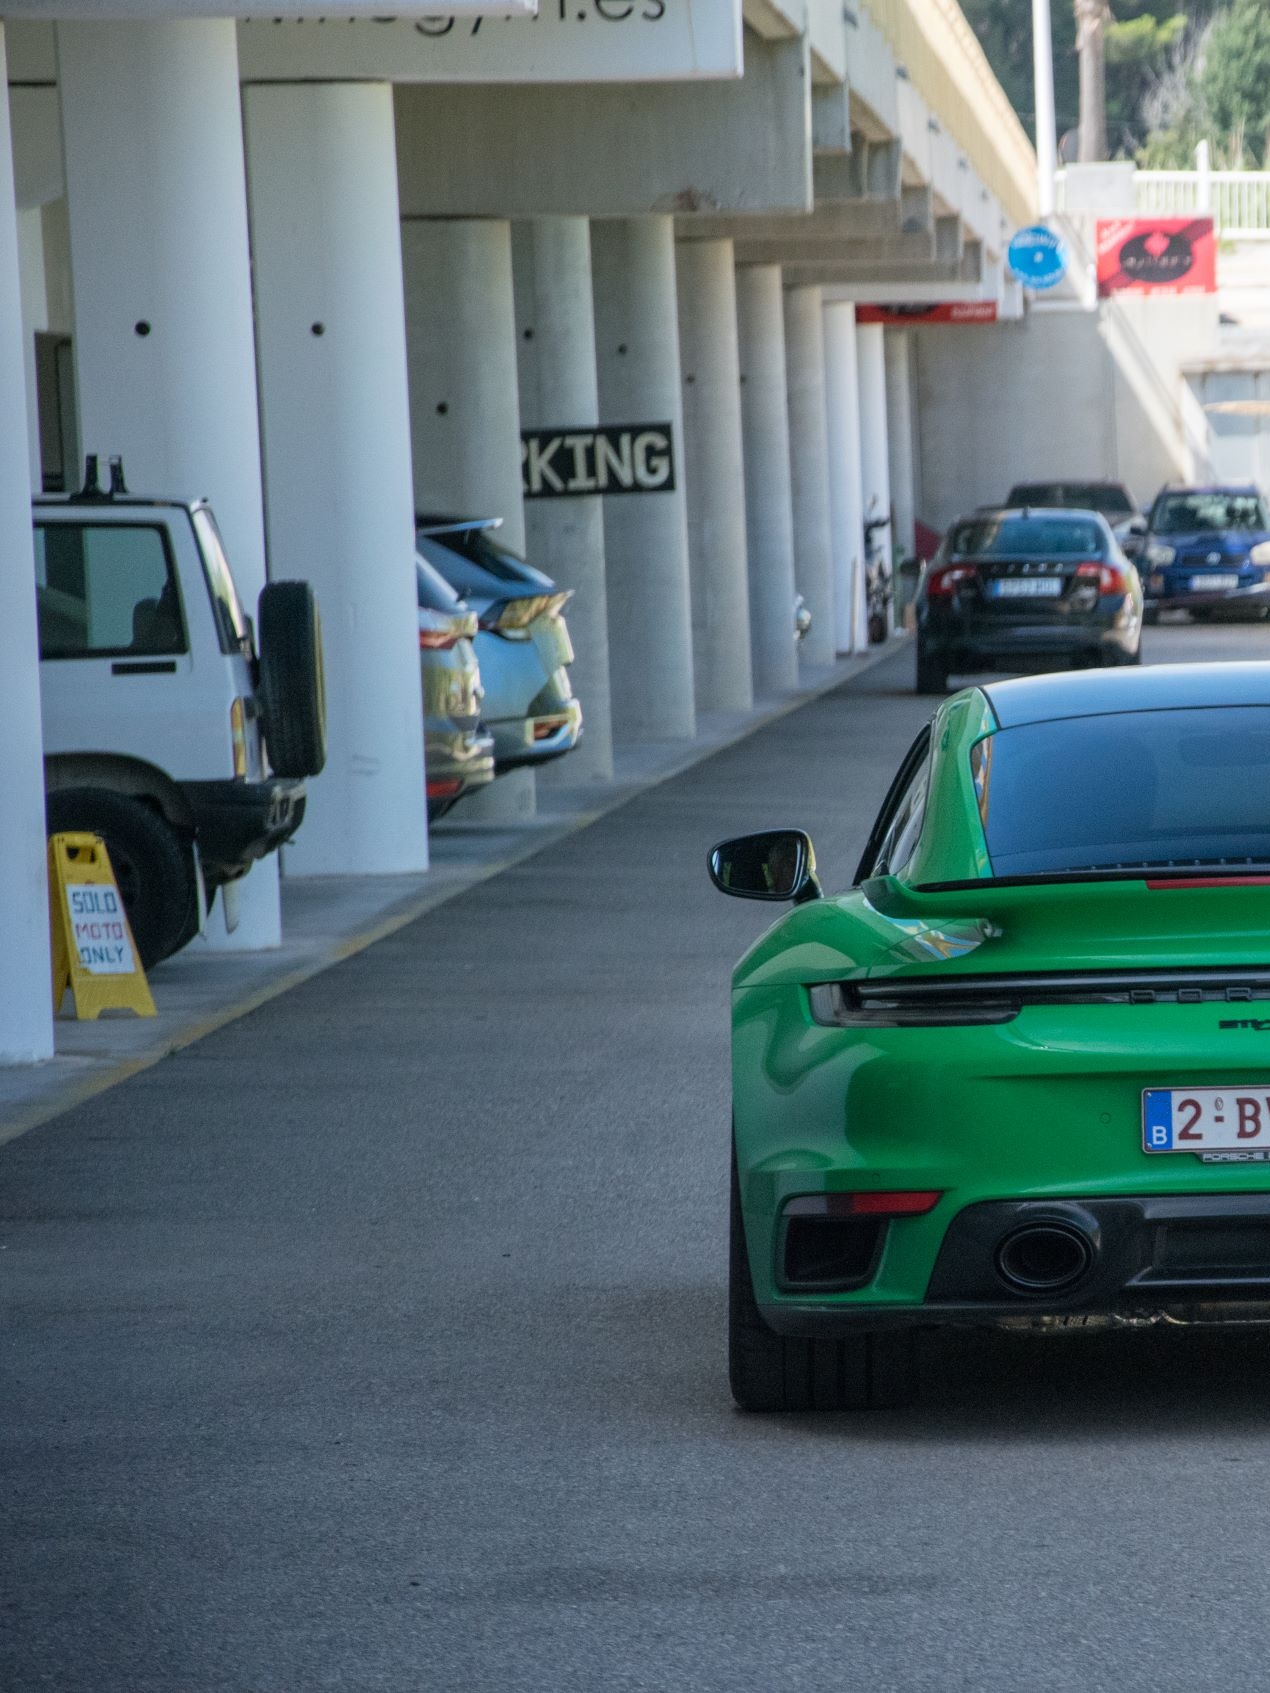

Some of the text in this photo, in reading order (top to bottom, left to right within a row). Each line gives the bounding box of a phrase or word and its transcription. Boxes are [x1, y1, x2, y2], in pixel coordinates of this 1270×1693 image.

[521, 431, 670, 494] KING
[72, 891, 118, 914] SOLO
[75, 921, 124, 941] MOTO
[79, 946, 124, 964] ONLY
[1152, 1125, 1168, 1146] B
